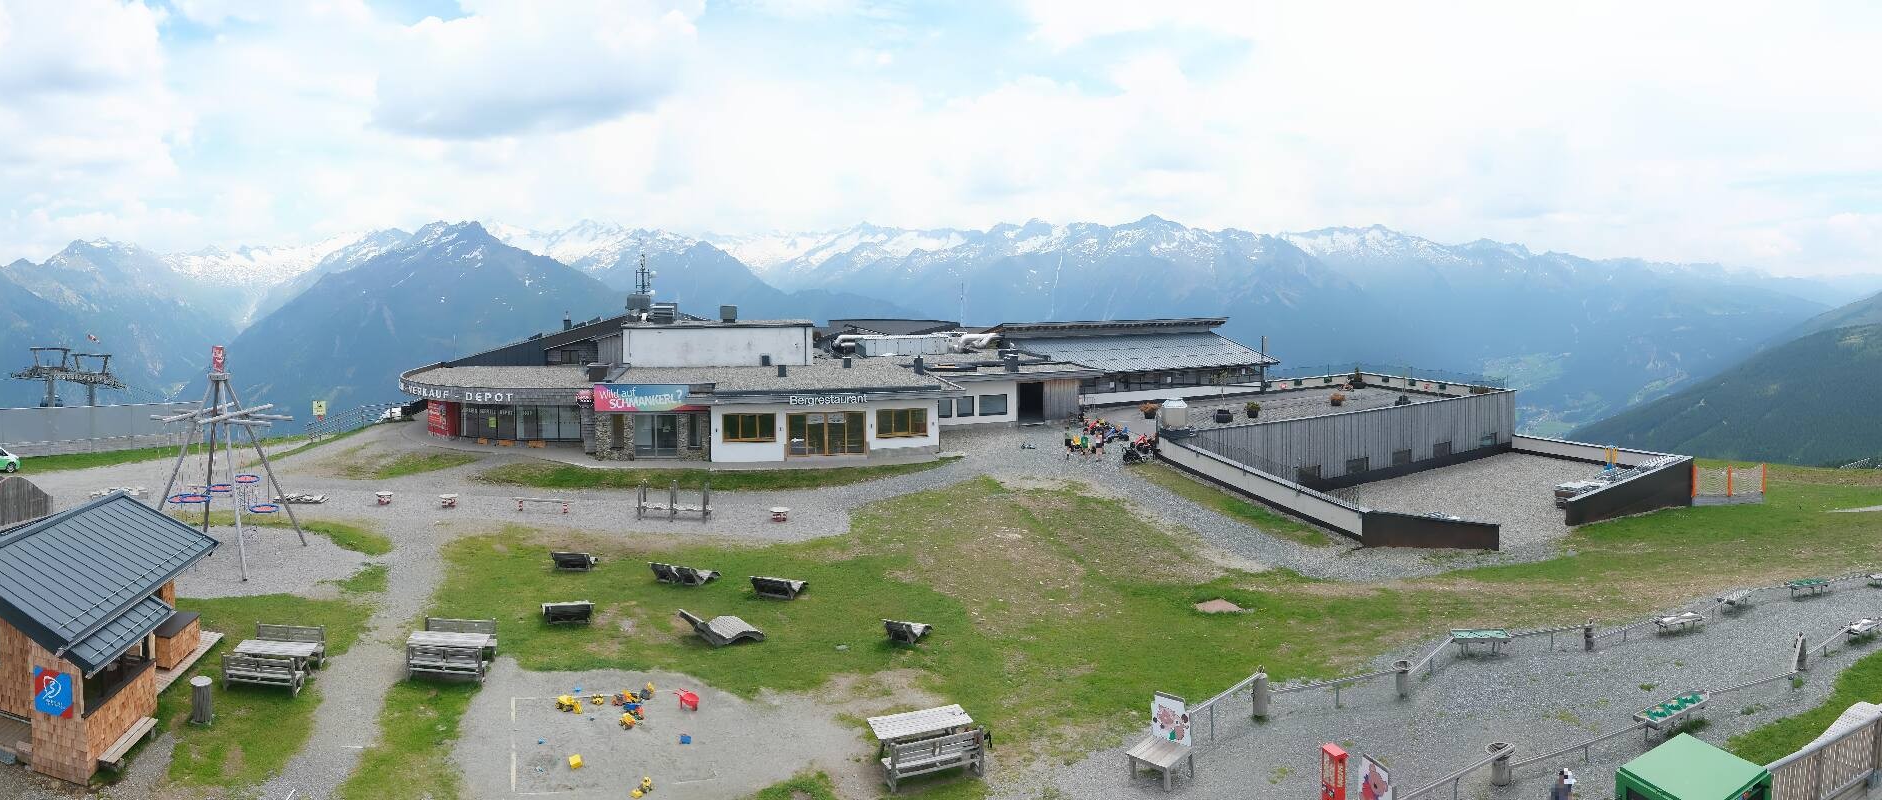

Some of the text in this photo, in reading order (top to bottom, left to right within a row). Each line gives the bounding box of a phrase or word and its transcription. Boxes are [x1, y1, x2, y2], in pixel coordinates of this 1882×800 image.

[409, 385, 449, 398] VERKAUF
[466, 391, 513, 402] DEPOT
[599, 389, 619, 400] Wild
[622, 386, 637, 398] auf
[789, 394, 868, 406] Bergrestaurant
